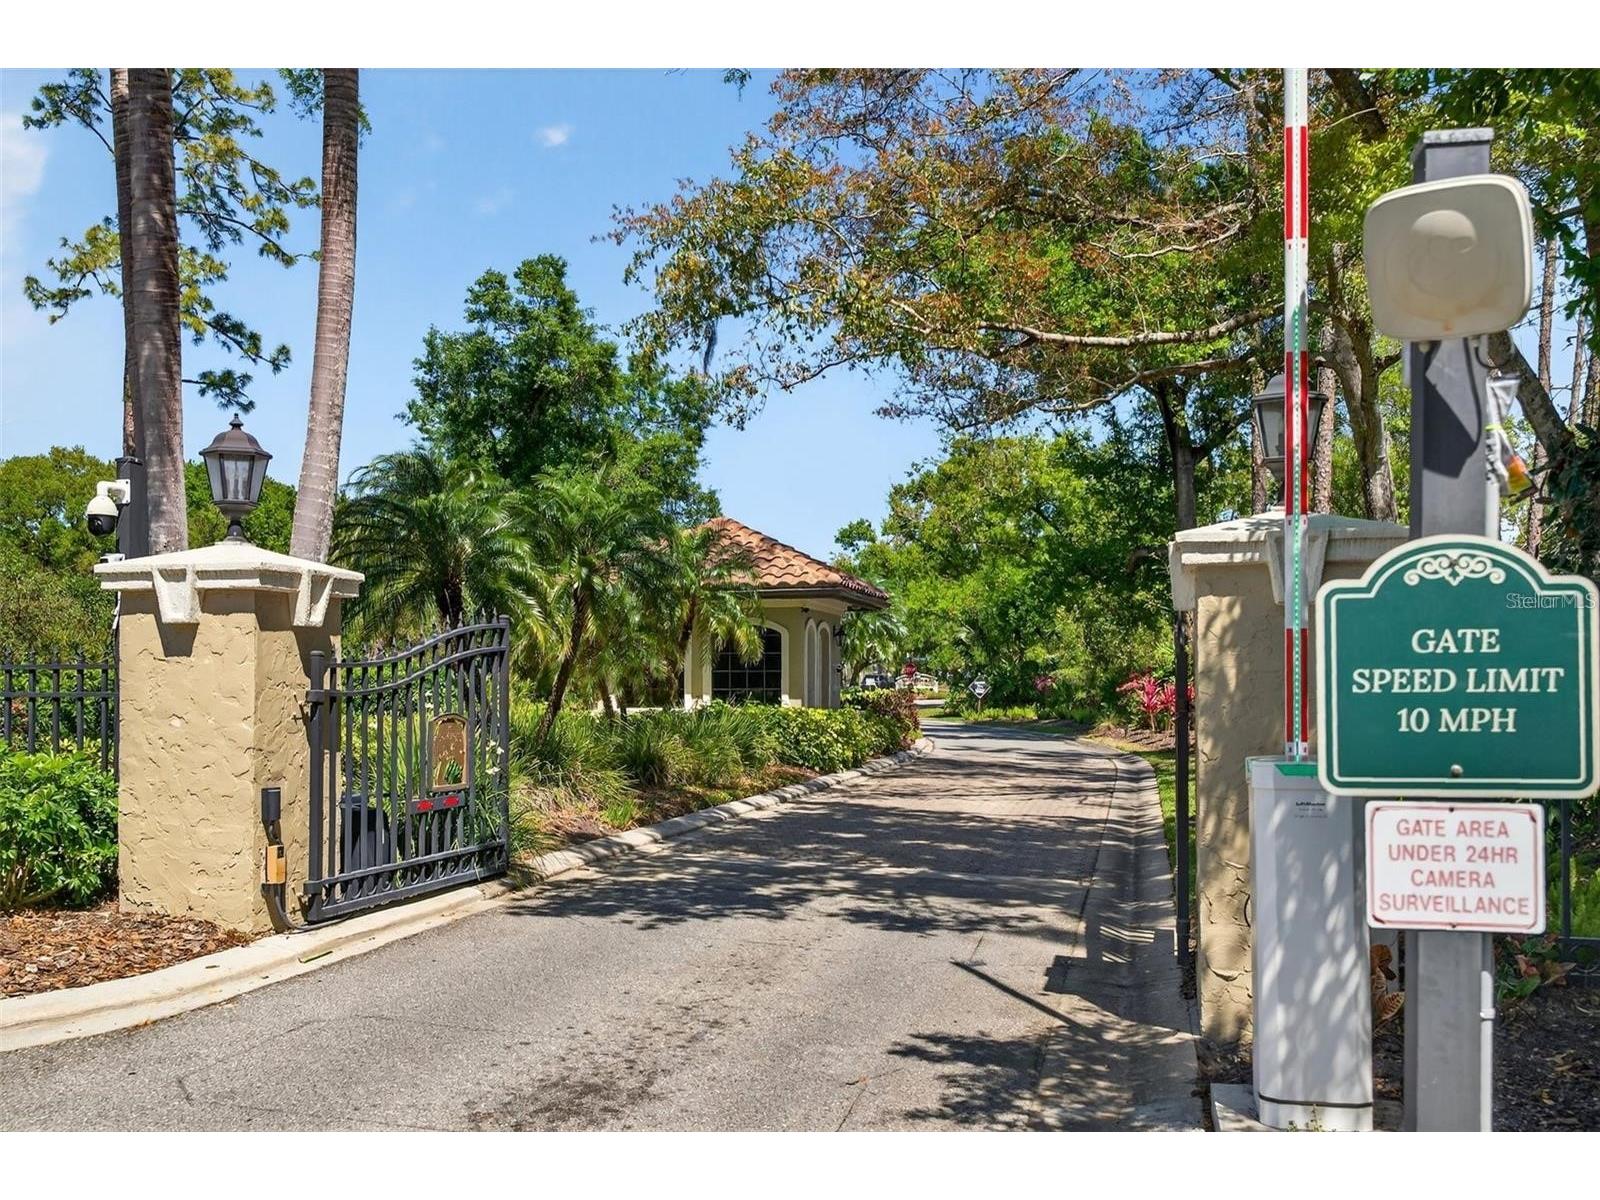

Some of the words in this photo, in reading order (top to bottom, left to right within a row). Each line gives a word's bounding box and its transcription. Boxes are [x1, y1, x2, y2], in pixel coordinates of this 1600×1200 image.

[1412, 628, 1500, 653] GATE
[1352, 668, 1457, 694] SPEED
[1466, 667, 1565, 693] LIMIT
[1397, 708, 1430, 732] 10
[1438, 708, 1517, 733] MPH
[1396, 819, 1446, 838] GATE
[1456, 820, 1510, 839] AREA
[1388, 844, 1456, 863] UNDER
[1466, 846, 1518, 864] 24HR
[1411, 869, 1495, 889] CAMERA
[1379, 893, 1530, 916] SURVEILLANCE
